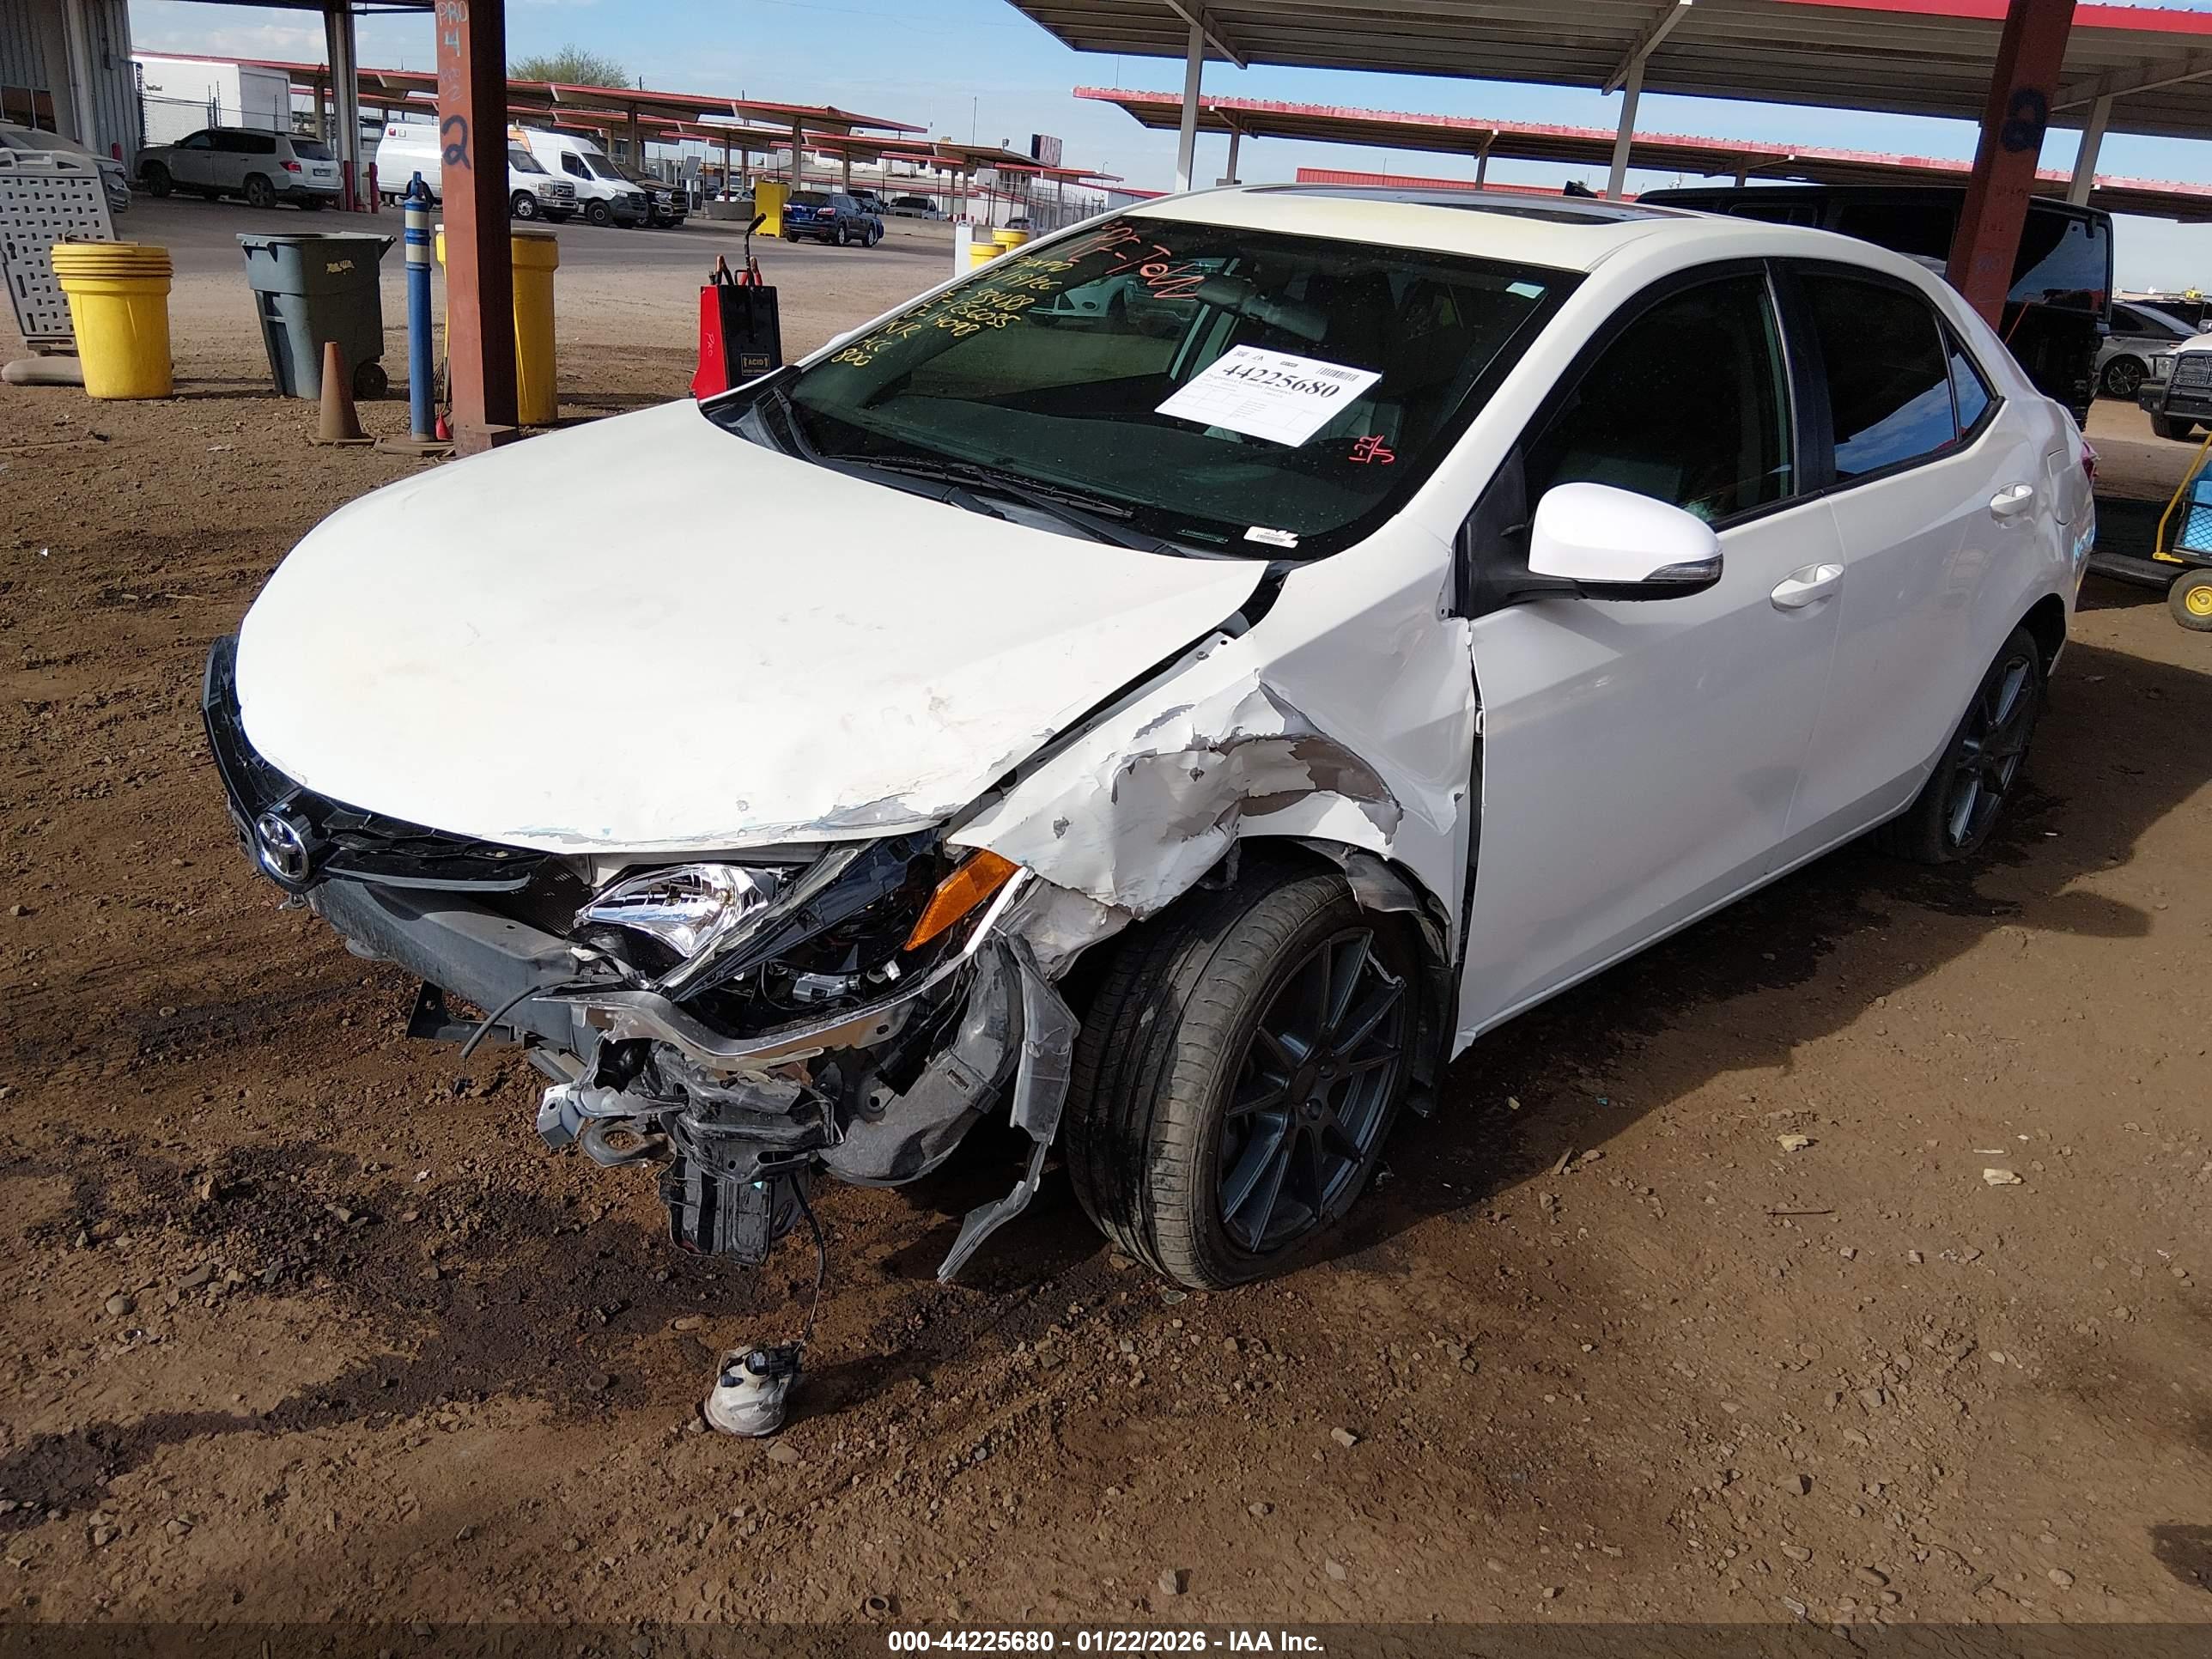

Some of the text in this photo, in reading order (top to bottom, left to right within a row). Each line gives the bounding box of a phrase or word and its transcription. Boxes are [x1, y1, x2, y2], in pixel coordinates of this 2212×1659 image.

[444, 27, 461, 58] 4
[441, 114, 471, 170] 2
[1223, 364, 1340, 398] 44225680
